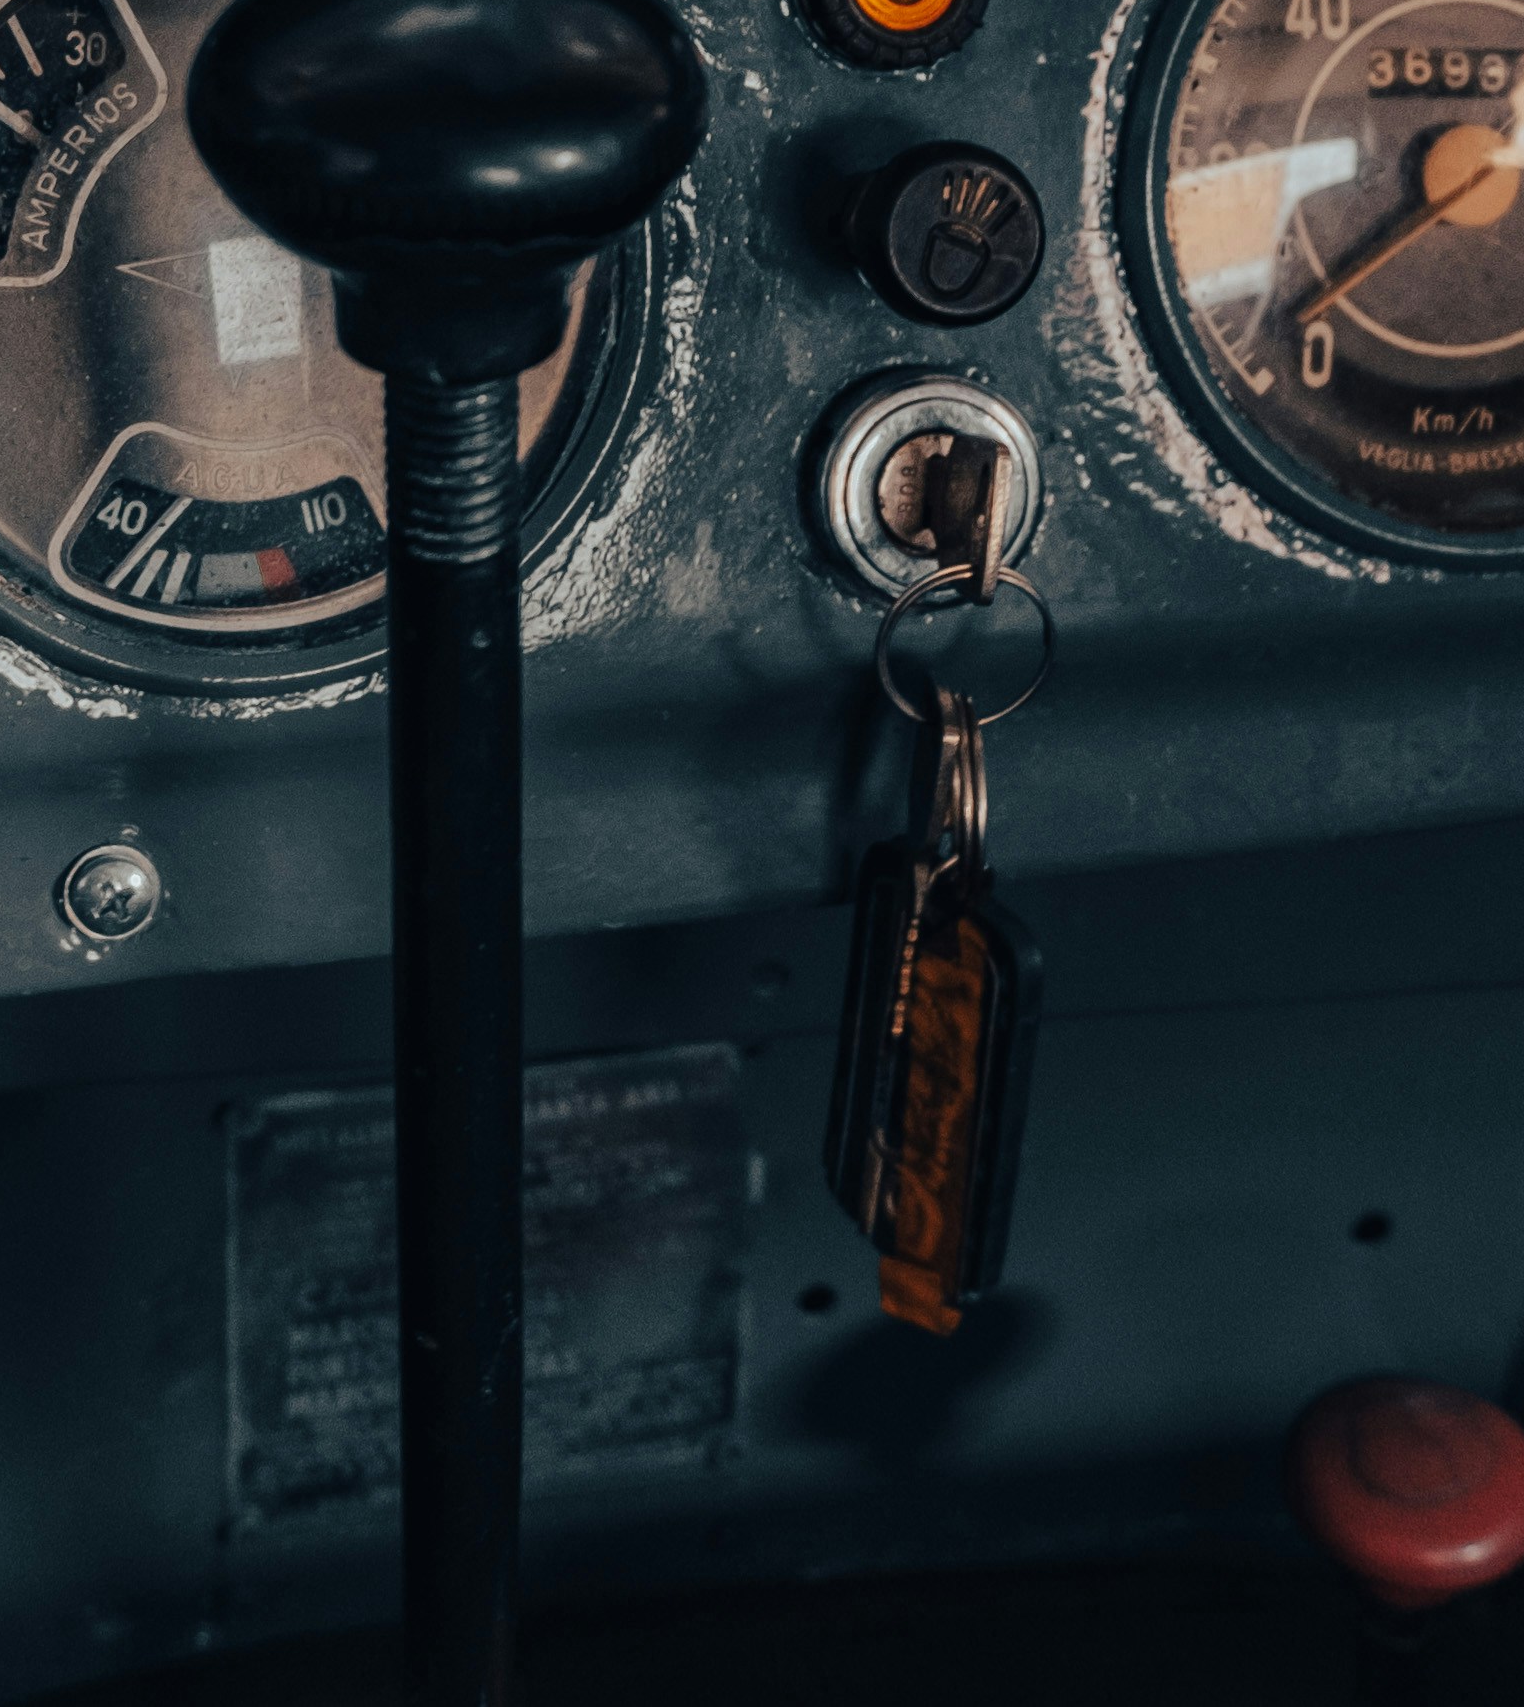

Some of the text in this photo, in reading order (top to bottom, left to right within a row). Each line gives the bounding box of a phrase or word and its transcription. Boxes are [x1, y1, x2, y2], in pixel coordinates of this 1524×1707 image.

[64, 28, 108, 66] 30
[1301, 320, 1335, 389] 0
[1410, 405, 1497, 436] Km/h
[172, 460, 302, 494] AGUA
[96, 496, 147, 536] 40
[301, 492, 348, 533] 110
